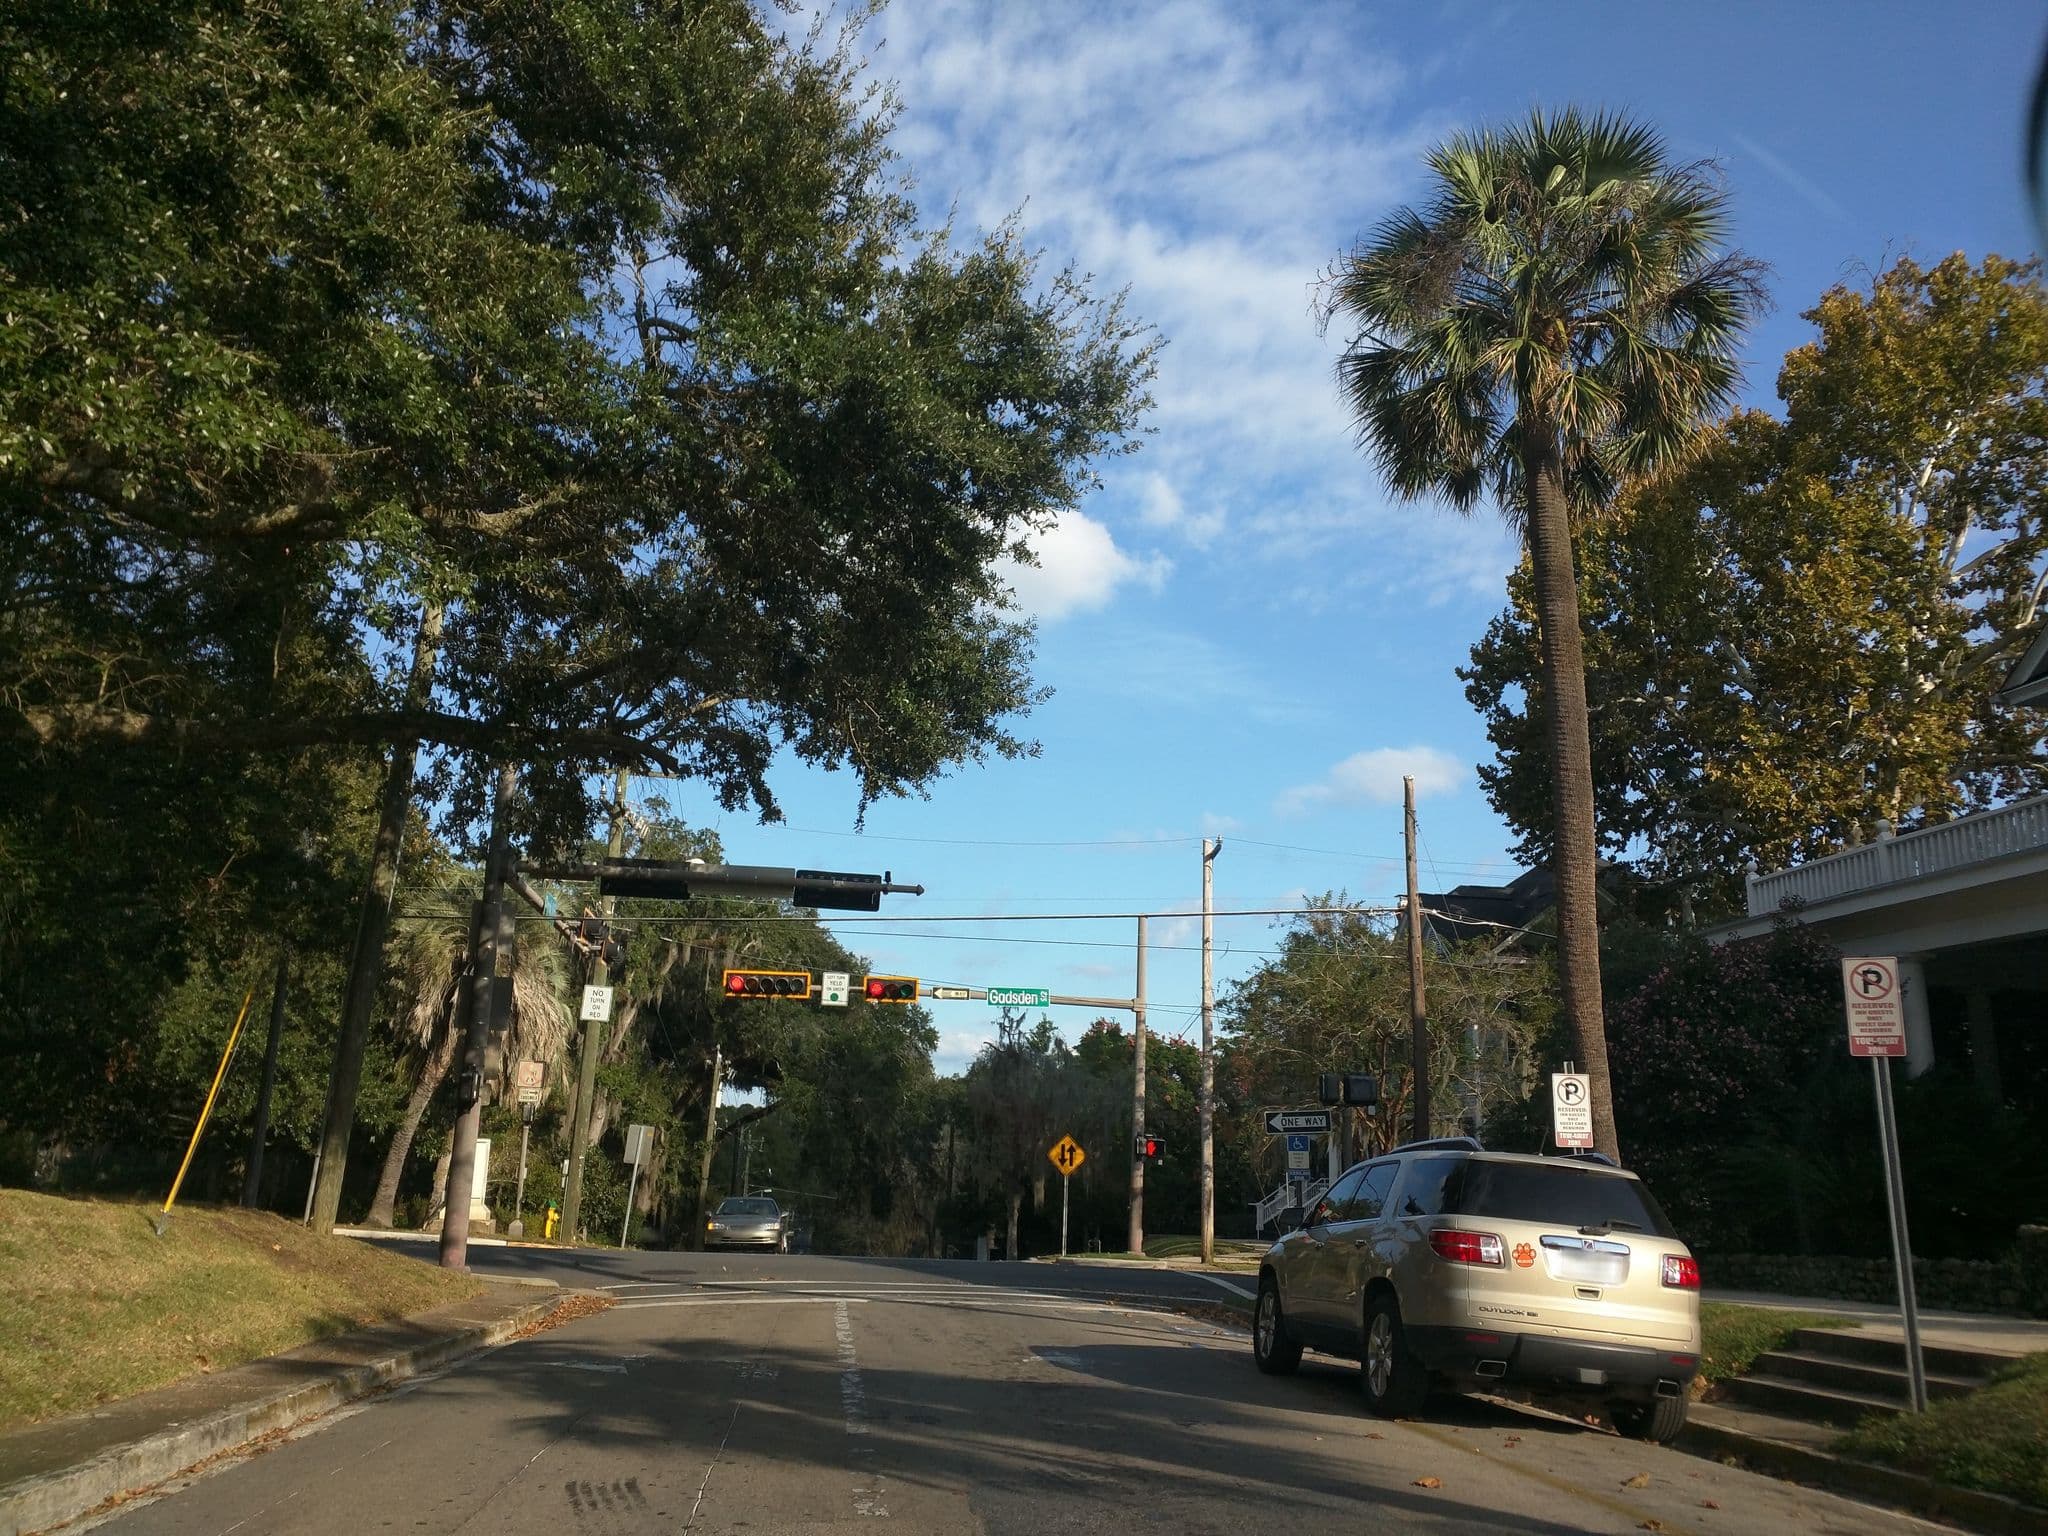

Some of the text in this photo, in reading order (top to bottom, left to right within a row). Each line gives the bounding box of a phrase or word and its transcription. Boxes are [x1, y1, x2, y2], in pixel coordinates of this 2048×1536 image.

[989, 990, 1037, 1004] Gadsden
[1867, 1046, 1888, 1055] ZONE
[1281, 1117, 1324, 1126] ONE WAY
[1479, 1306, 1525, 1315] OUTLOOK
